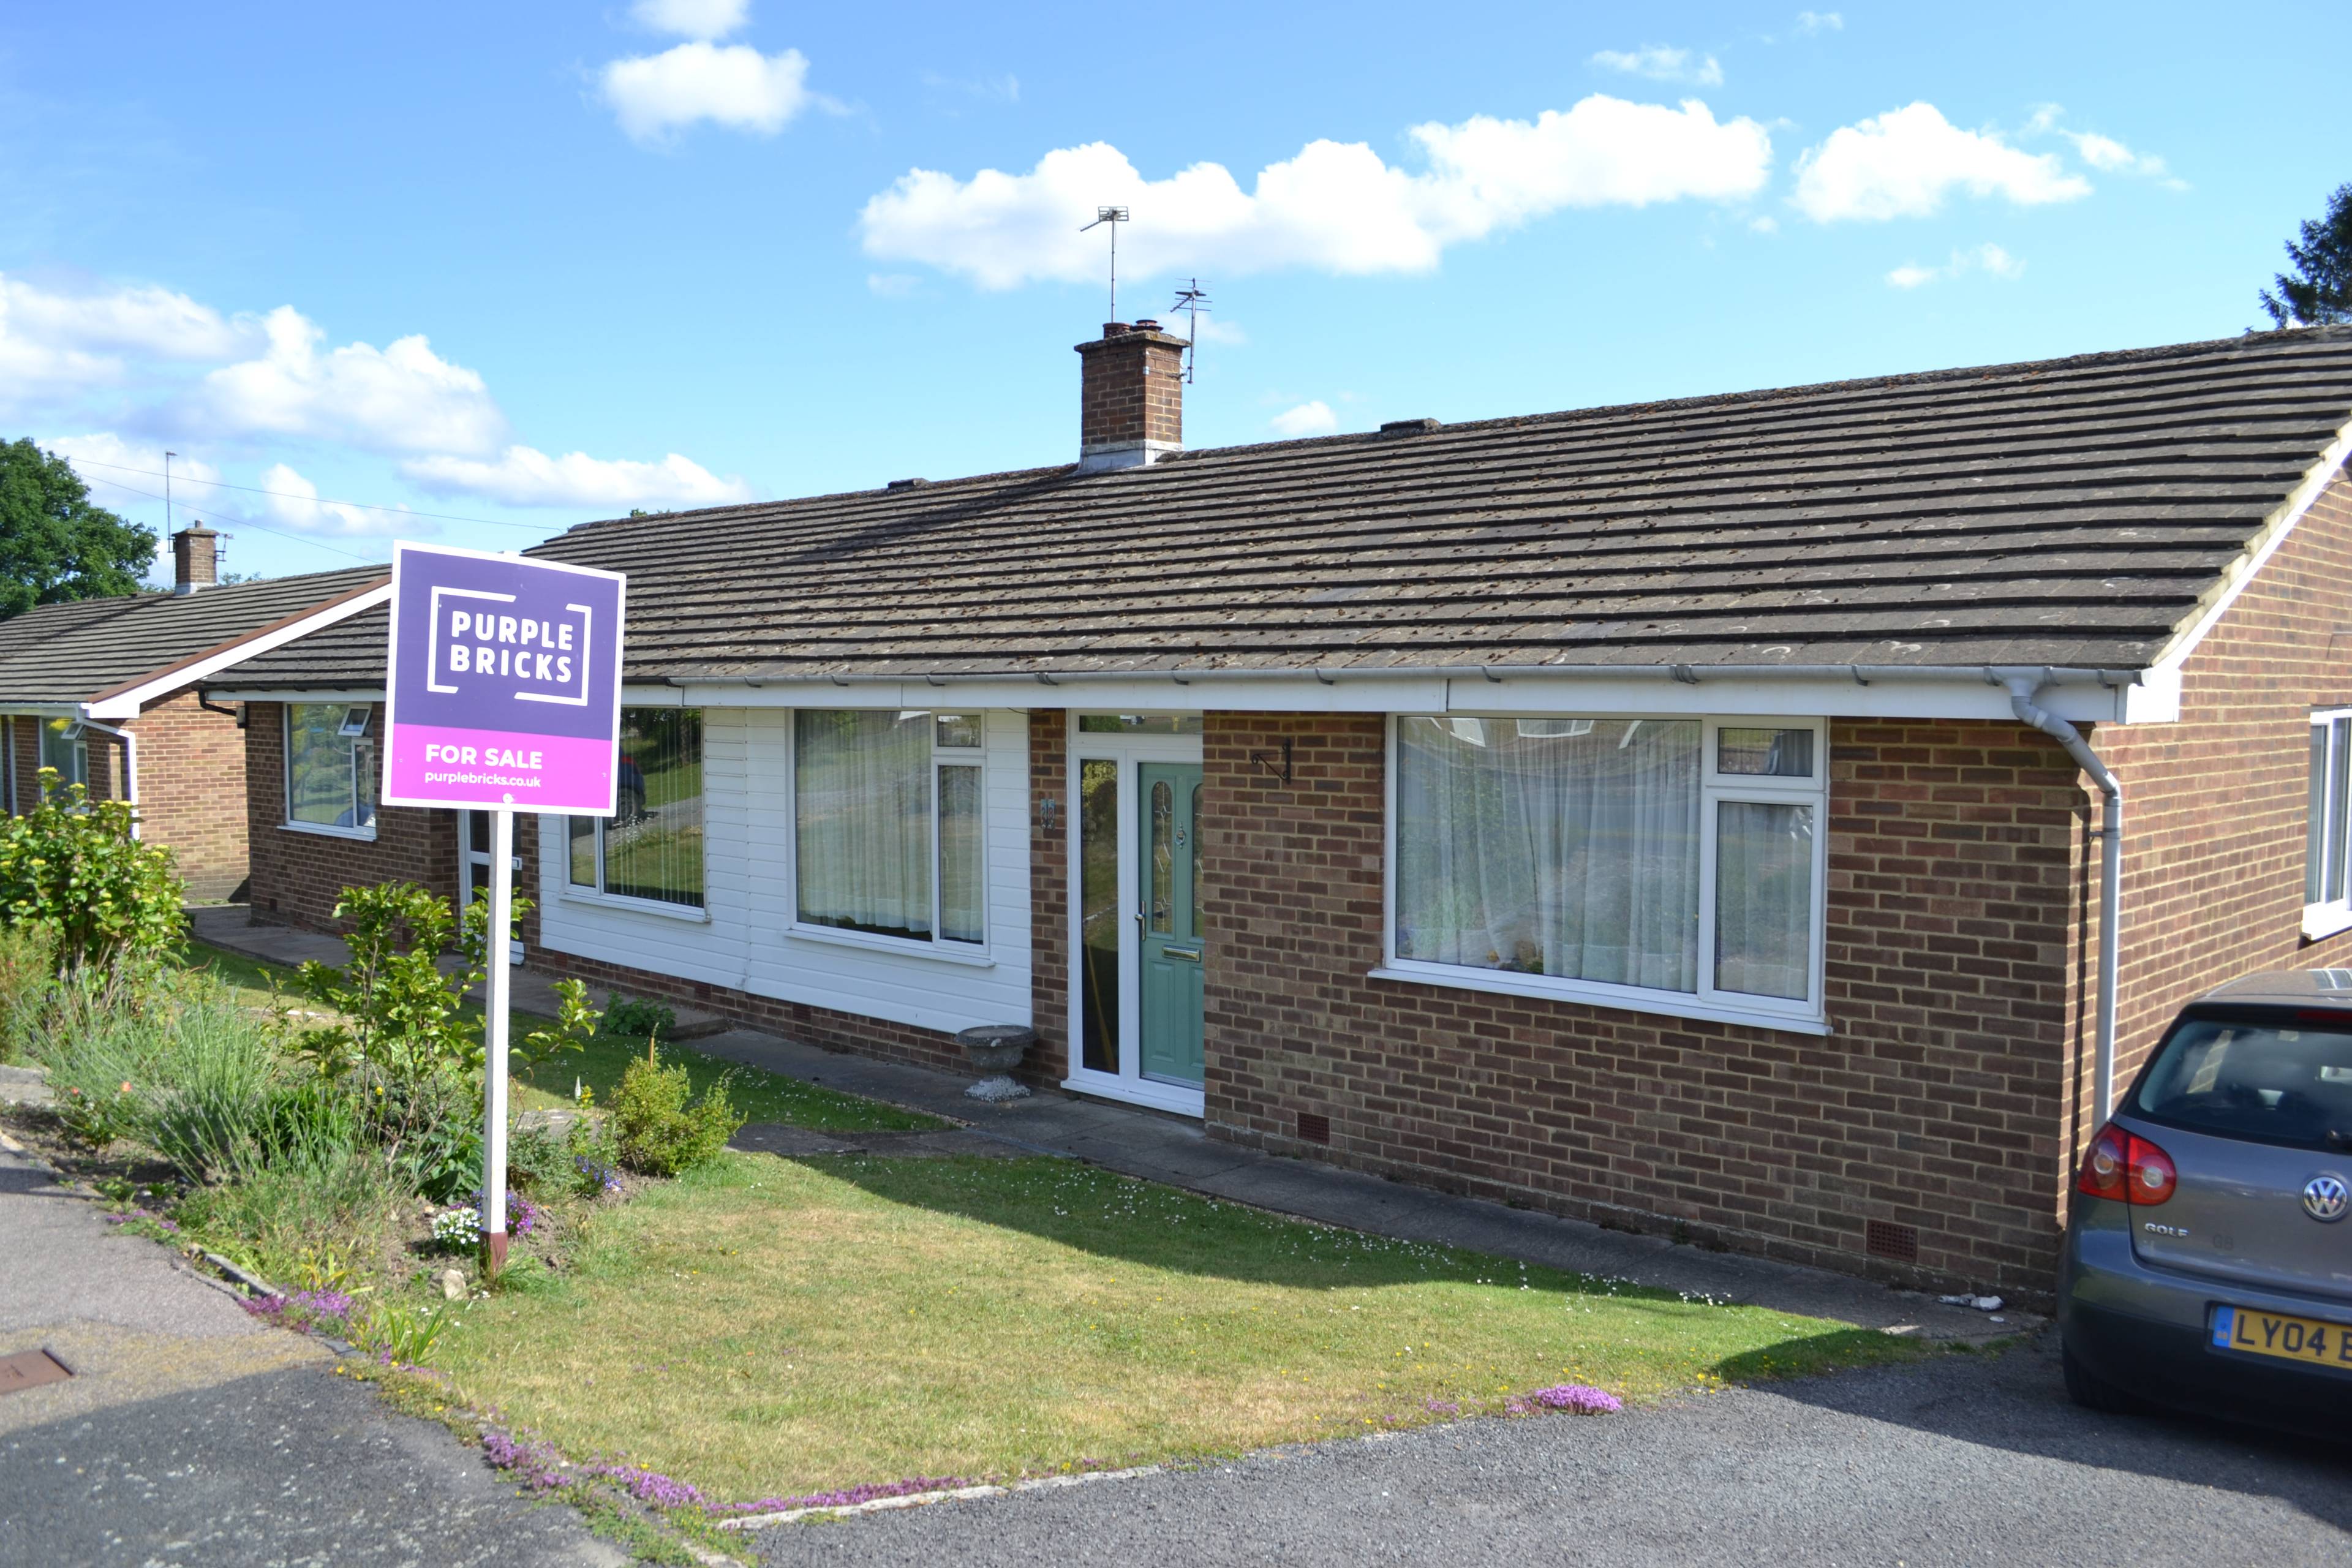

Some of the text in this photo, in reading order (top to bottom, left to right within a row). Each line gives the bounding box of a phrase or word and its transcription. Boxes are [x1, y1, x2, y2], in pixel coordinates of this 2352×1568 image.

[451, 611, 573, 650] PURPLE
[450, 644, 572, 683] BRICKS
[426, 744, 543, 770] FOR SALE
[424, 771, 541, 788] purplebricks.co.uk
[2144, 1223, 2189, 1237] GOLF
[2236, 1314, 2326, 1357] LY04
